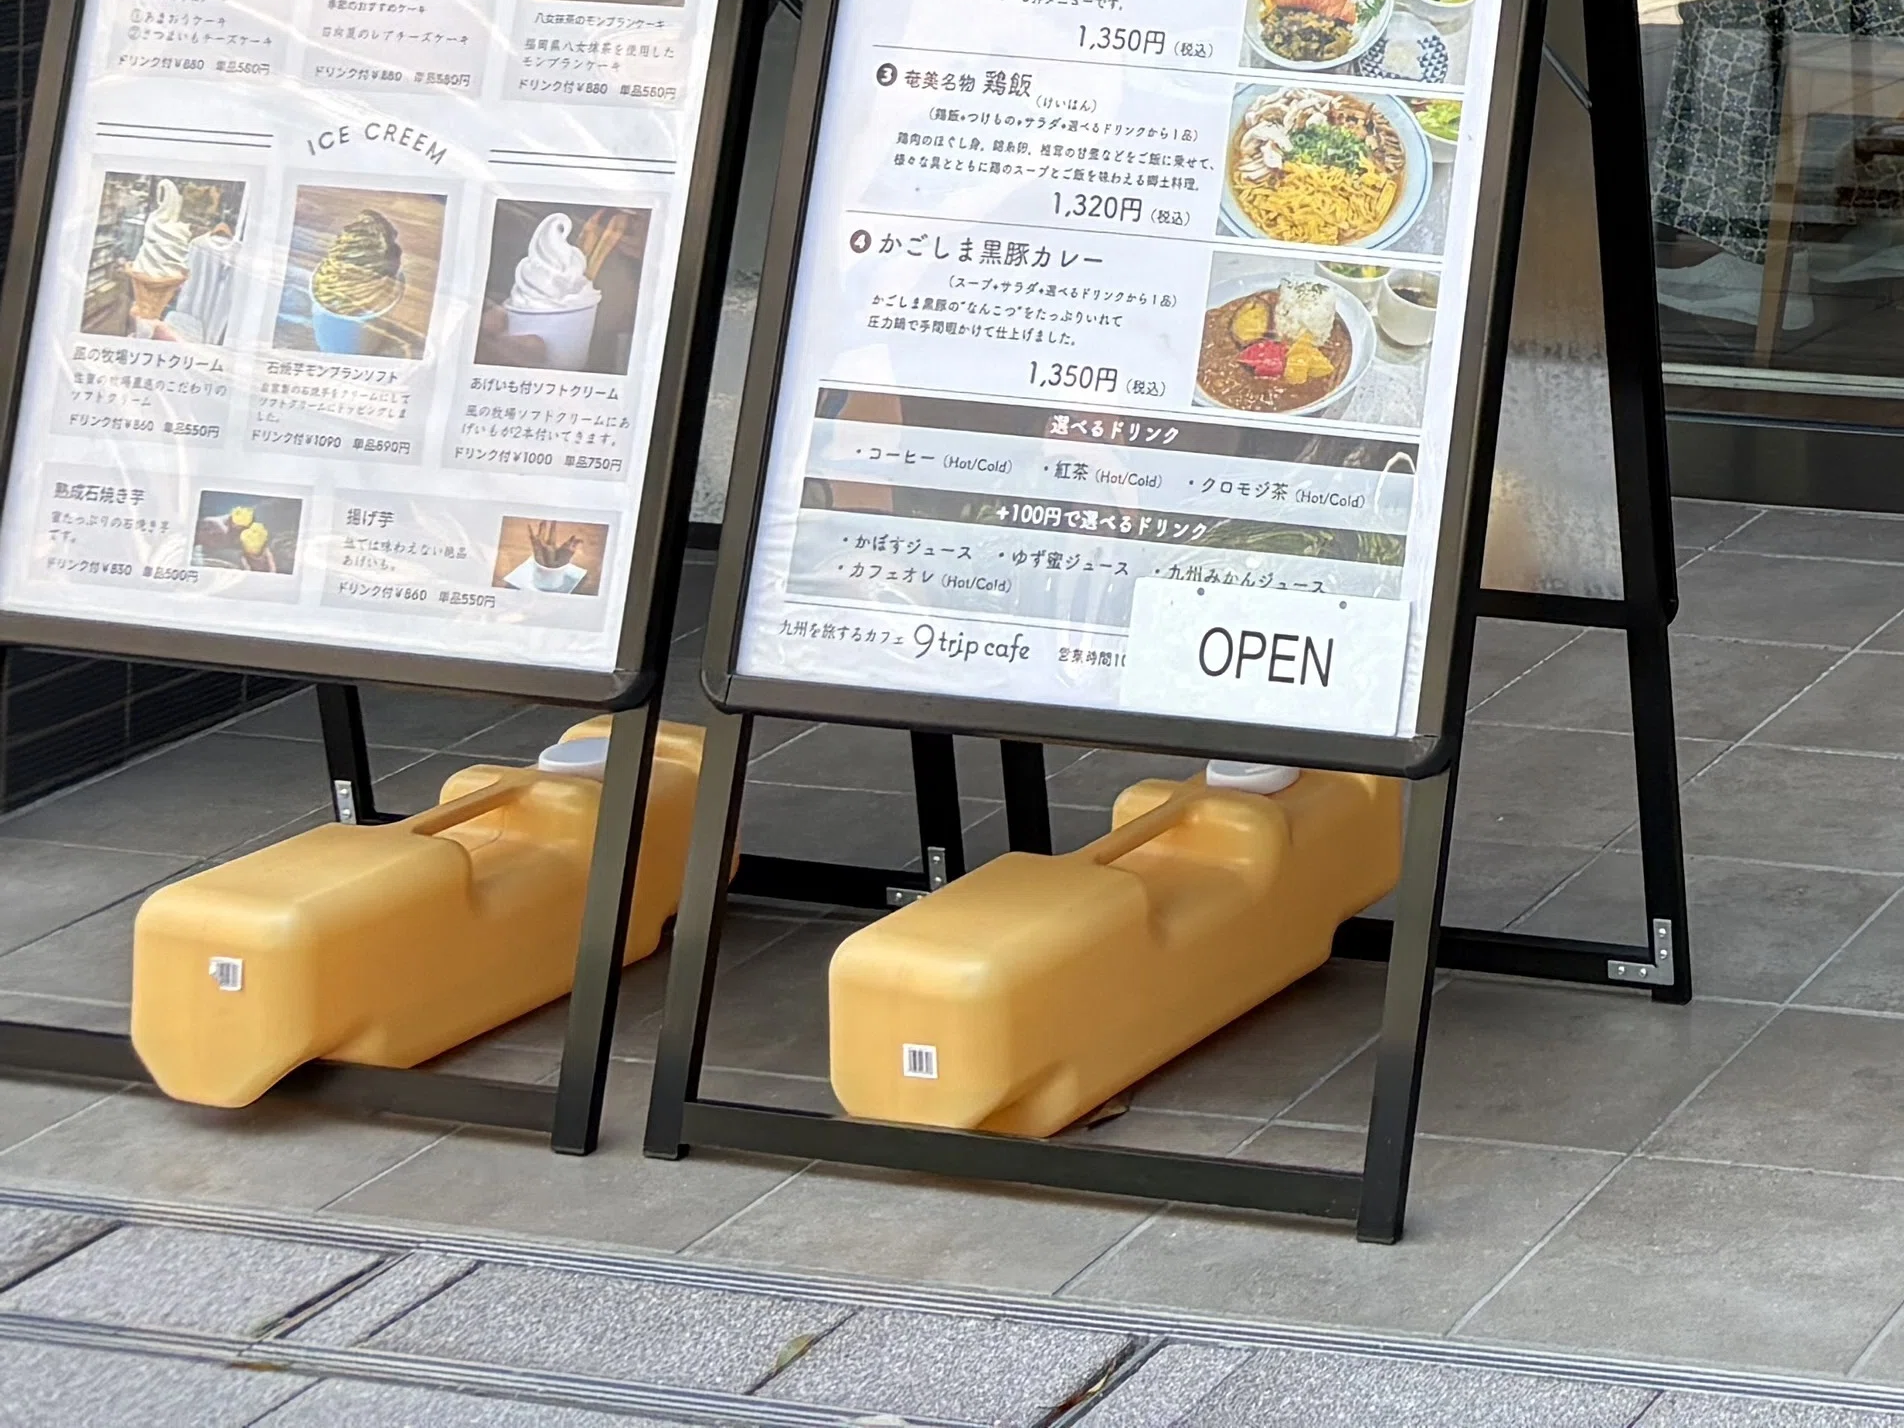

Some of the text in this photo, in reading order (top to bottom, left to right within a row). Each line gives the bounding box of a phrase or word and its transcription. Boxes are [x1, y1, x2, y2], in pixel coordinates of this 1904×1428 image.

[1077, 25, 1166, 55] 1,350円
[902, 69, 977, 94] 奄美名物
[981, 69, 1033, 97] 鶏飯
[306, 121, 449, 166] ICE CREEM
[1050, 191, 1143, 223] 1,320円
[877, 230, 1105, 273] かごしま黒豚カレー
[469, 375, 620, 402] あげいも付ソフトクリーム
[1026, 360, 1118, 393] 1,350円
[1049, 414, 1181, 446] 選べるドリンク
[563, 454, 622, 473] 単品750円
[345, 506, 395, 529] 揚げ芋
[778, 619, 905, 647] 九州を旅するカフェ
[983, 630, 1031, 664] cafe
[1196, 625, 1334, 687] OPEN
